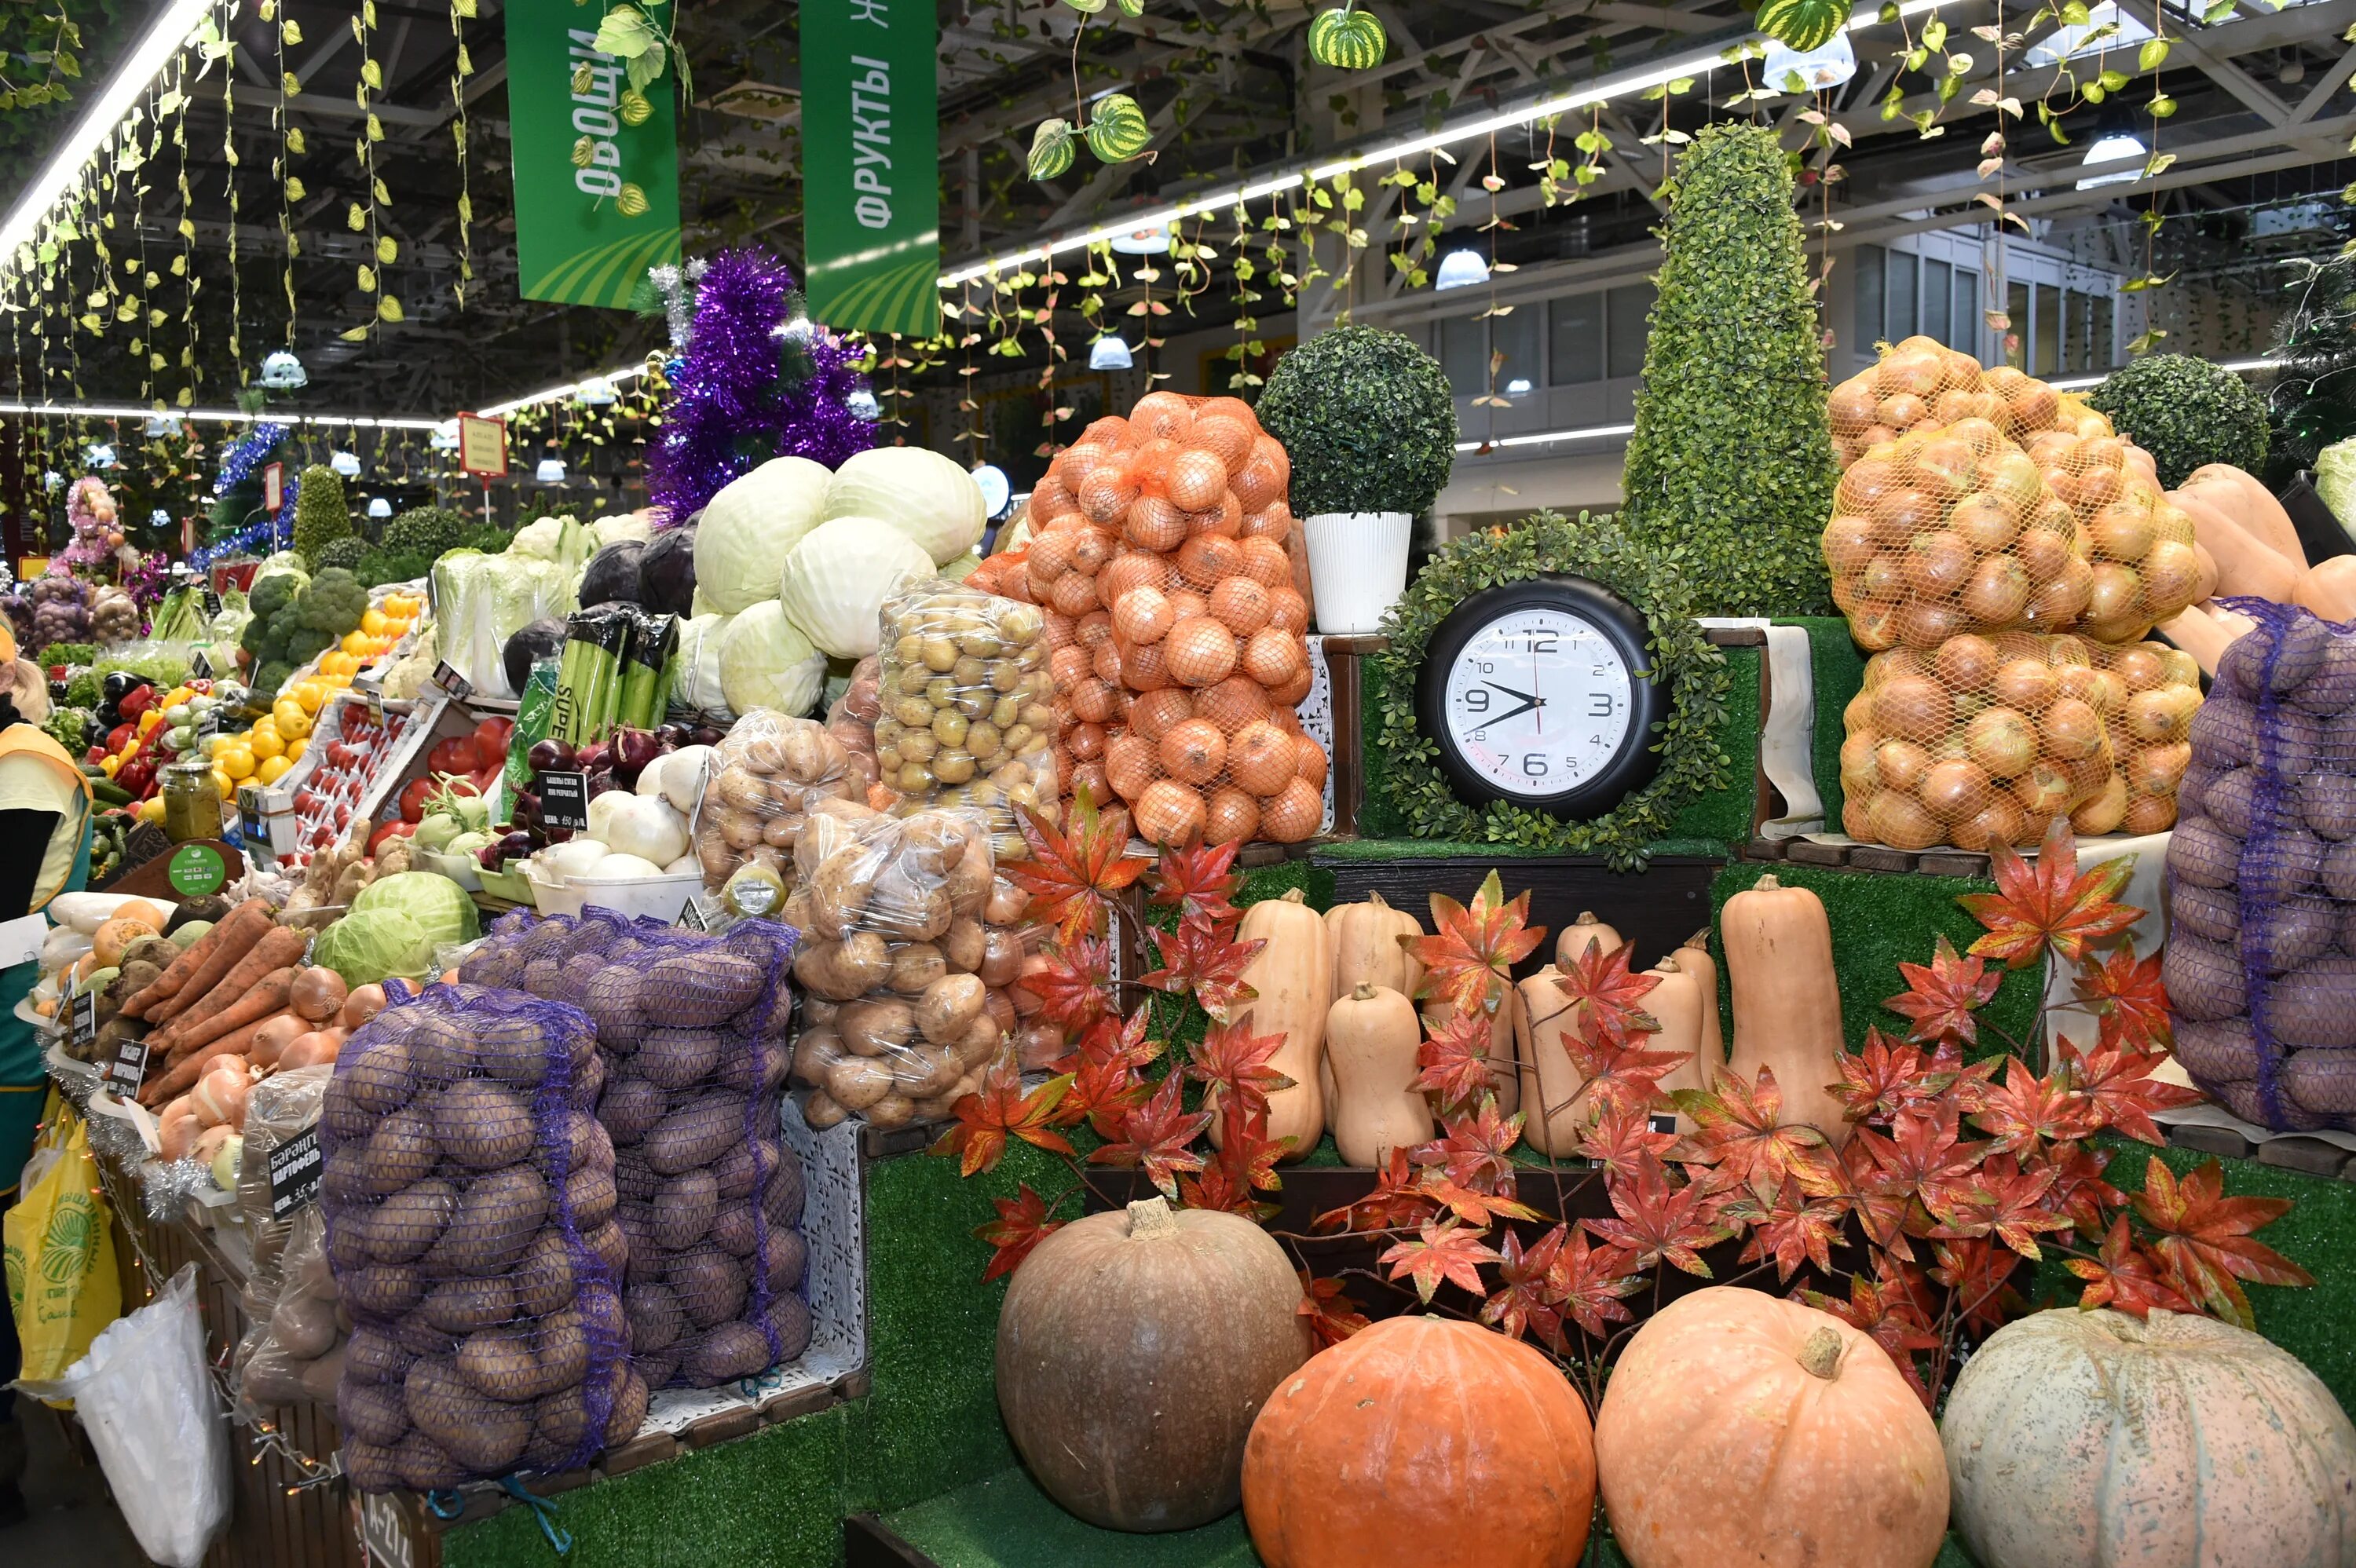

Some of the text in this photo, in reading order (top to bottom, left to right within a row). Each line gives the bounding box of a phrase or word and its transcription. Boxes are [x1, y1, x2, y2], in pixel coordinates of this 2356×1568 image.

[568, 28, 625, 199] ОВОЩИ
[851, 55, 891, 229] ФРУКТЫ
[1522, 629, 1559, 653] 12
[1477, 663, 1494, 674] 10
[1593, 664, 1604, 677] 2
[1465, 689, 1490, 712] 9
[1588, 693, 1613, 717] 3
[1474, 730, 1487, 741] 8
[1589, 734, 1601, 746] 4
[1498, 754, 1509, 766] 7
[1523, 753, 1548, 777] 6
[1565, 756, 1578, 768] 5
[273, 1147, 321, 1186] КАРТОФЕЛЬ
